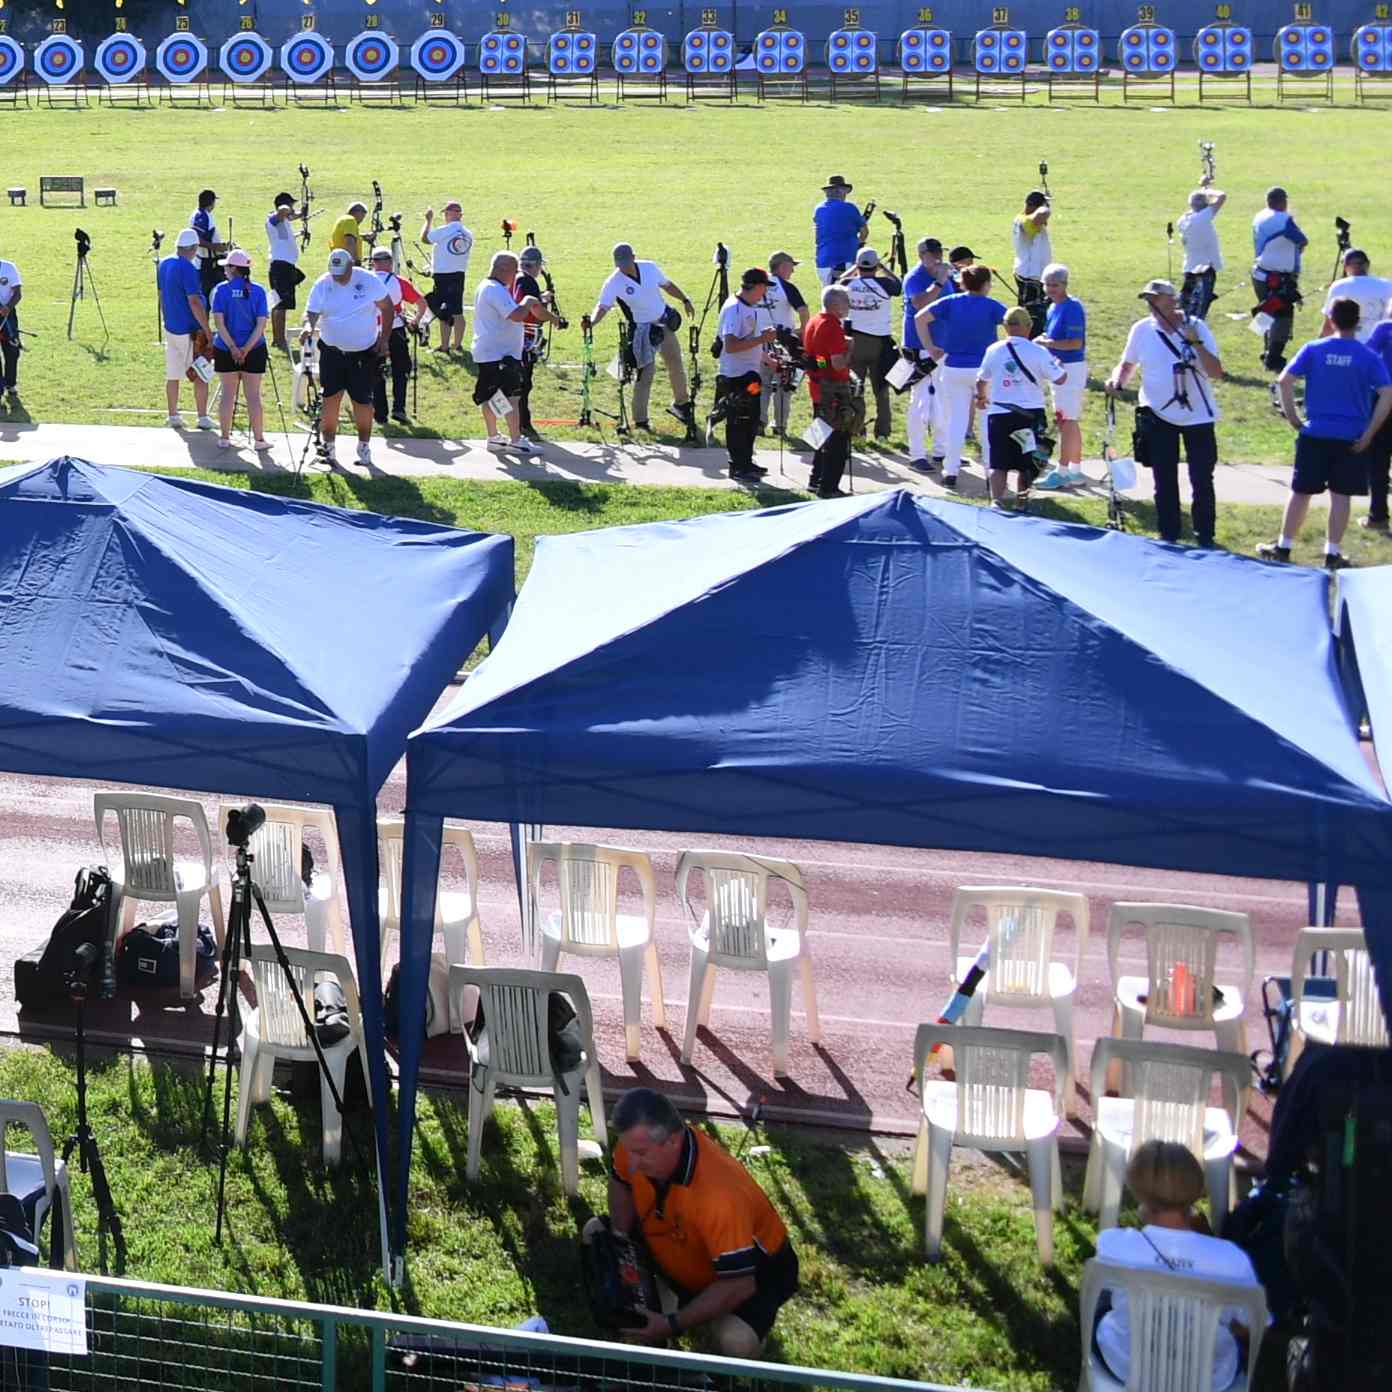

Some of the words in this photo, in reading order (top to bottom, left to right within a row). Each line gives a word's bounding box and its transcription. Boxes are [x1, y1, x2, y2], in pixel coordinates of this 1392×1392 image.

[303, 16, 313, 28] 27
[431, 14, 443, 26] 29
[568, 12, 579, 24] 31
[1325, 353, 1353, 367] STAFF
